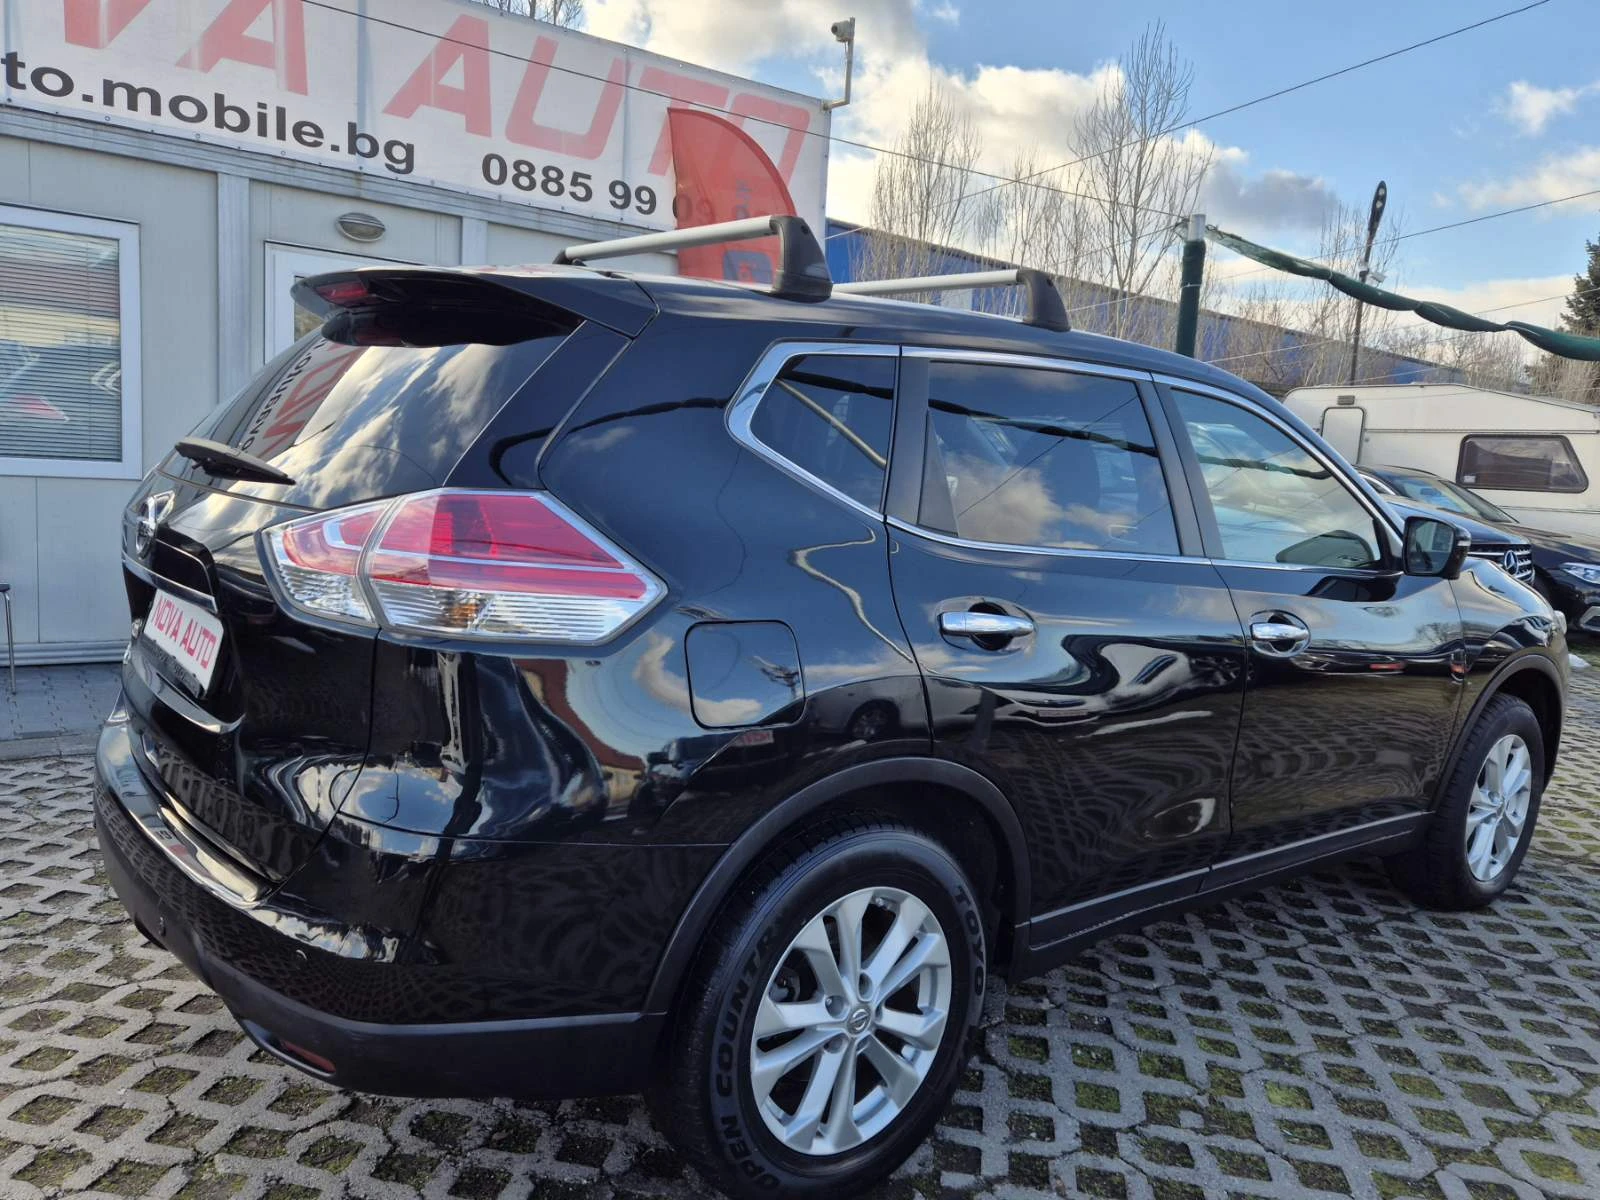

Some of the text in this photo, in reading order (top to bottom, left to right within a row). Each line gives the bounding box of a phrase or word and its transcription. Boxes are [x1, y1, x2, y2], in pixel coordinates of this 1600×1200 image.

[1, 51, 415, 175] to.mobile.bg
[481, 152, 594, 203] 0885
[608, 179, 658, 216] 99
[152, 595, 184, 643] NOVA
[179, 617, 218, 670] AUTO
